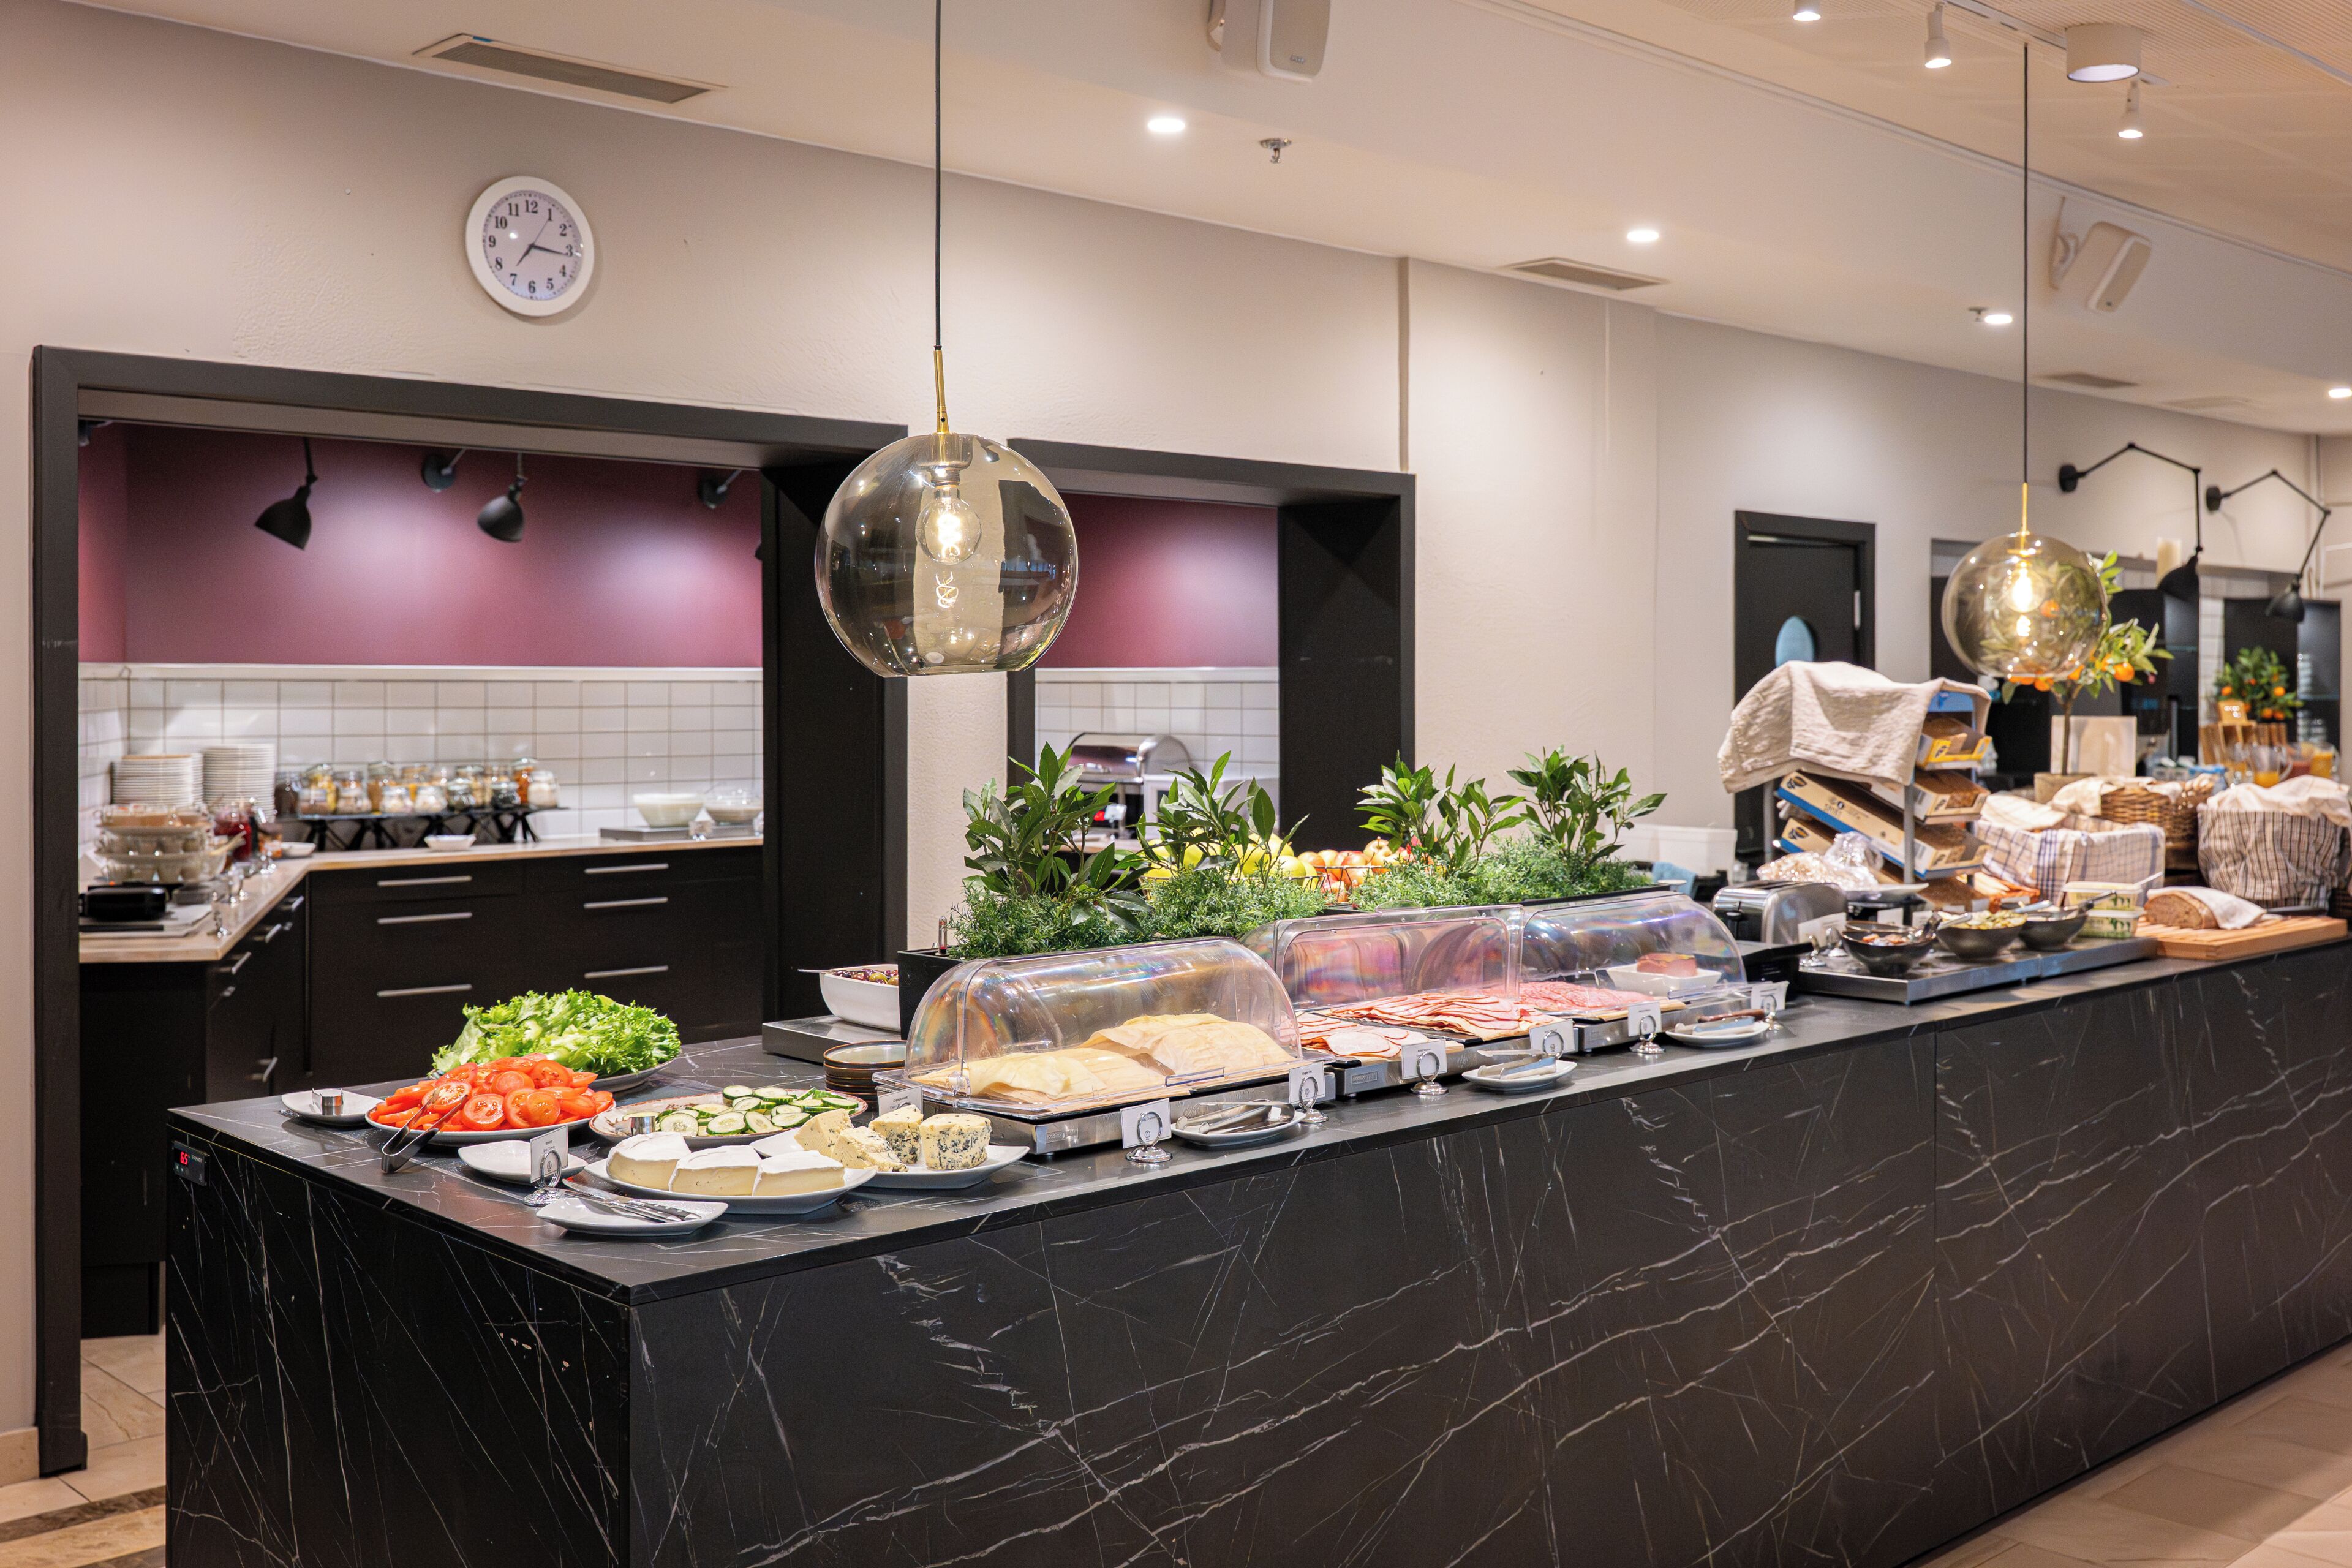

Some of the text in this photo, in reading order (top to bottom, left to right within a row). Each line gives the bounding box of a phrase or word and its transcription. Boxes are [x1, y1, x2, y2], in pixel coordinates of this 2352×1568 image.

[508, 203, 519, 217] 11
[525, 200, 538, 214] 12
[548, 208, 552, 222] 1
[495, 216, 508, 229] 10
[559, 223, 567, 236] 2
[488, 235, 496, 247] 9
[565, 244, 573, 257] 3
[495, 257, 503, 270] 8
[559, 264, 566, 277] 4
[510, 273, 517, 286] 7
[546, 278, 554, 290] 5
[529, 280, 536, 293] 6
